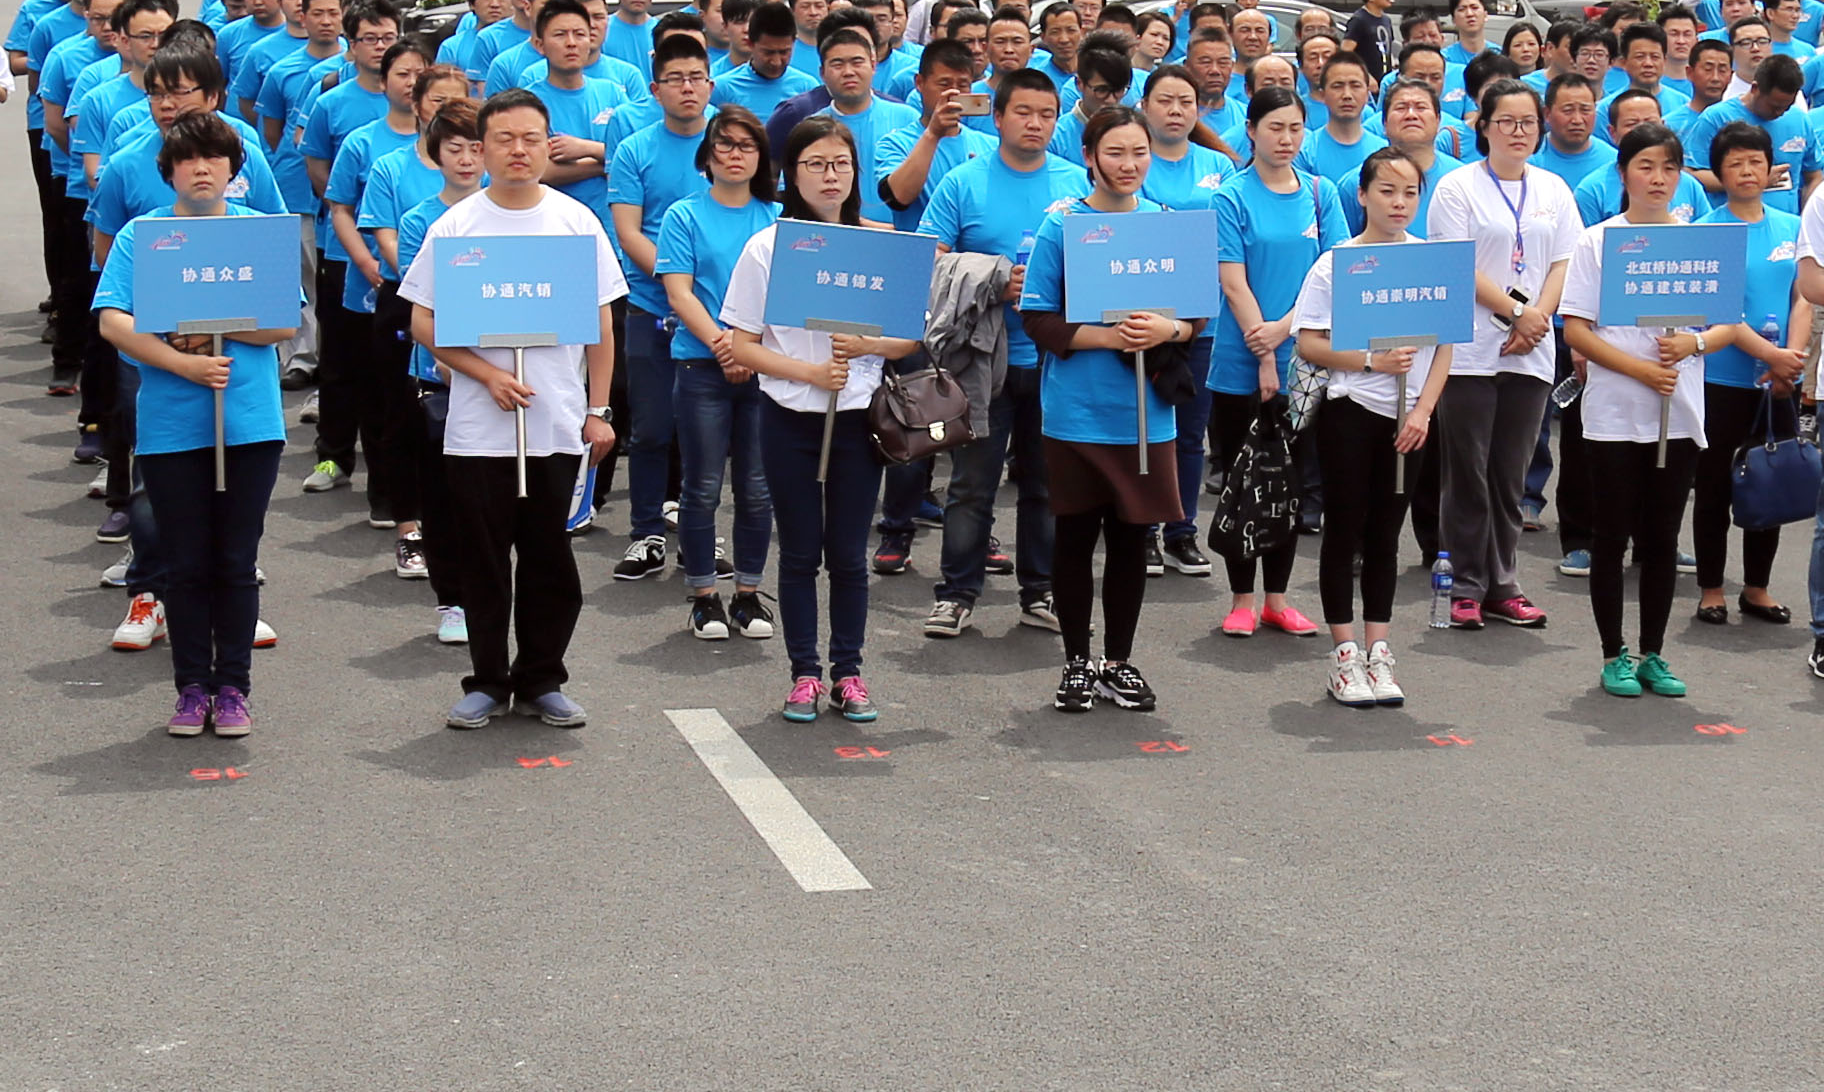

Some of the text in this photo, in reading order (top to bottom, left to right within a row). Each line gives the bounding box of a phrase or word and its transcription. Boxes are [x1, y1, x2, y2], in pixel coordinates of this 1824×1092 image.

[1110, 258, 1175, 275] 协通众明
[1625, 260, 1720, 275] 北虹桥协通科技
[182, 266, 253, 283] 协通众盛
[816, 269, 885, 291] 协通锦发
[481, 282, 551, 298] 协通汽销
[1360, 285, 1448, 304] 协通崇明汽销
[1624, 280, 1720, 295] 协通建筑装潢
[833, 745, 891, 759] 13
[1135, 740, 1191, 753] 12
[515, 755, 573, 770] 14
[188, 766, 249, 781] 15
